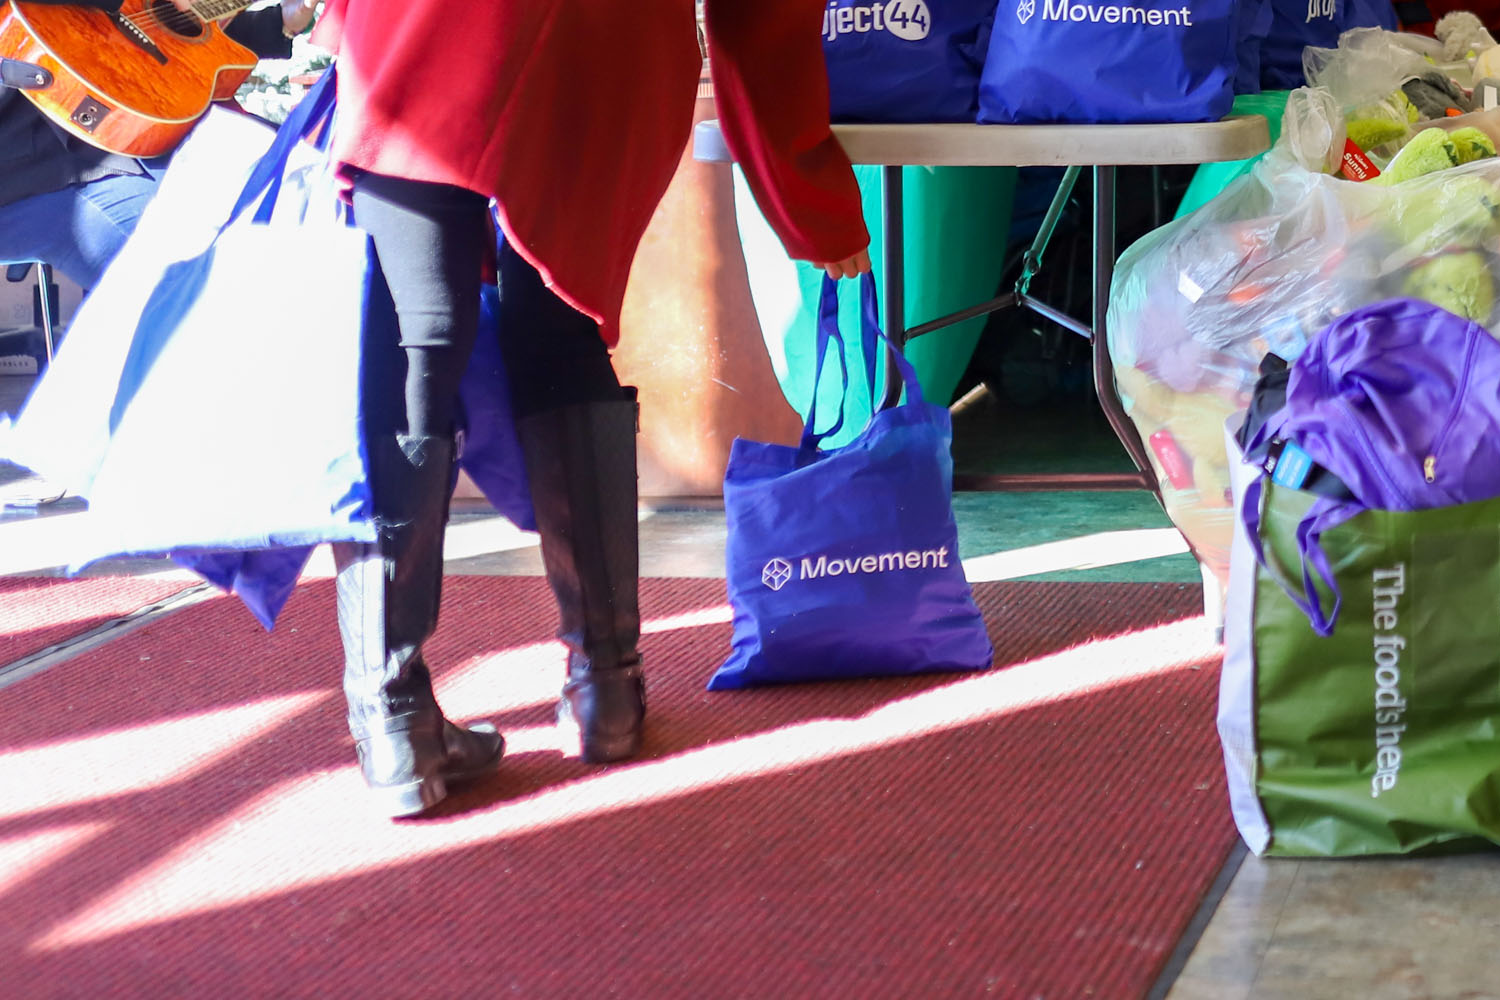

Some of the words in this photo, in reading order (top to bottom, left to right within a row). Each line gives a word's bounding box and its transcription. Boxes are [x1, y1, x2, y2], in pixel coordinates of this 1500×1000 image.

[1343, 152, 1367, 180] Sunny
[799, 546, 949, 581] Movement
[1372, 563, 1406, 631] The
[1373, 634, 1407, 725] food's
